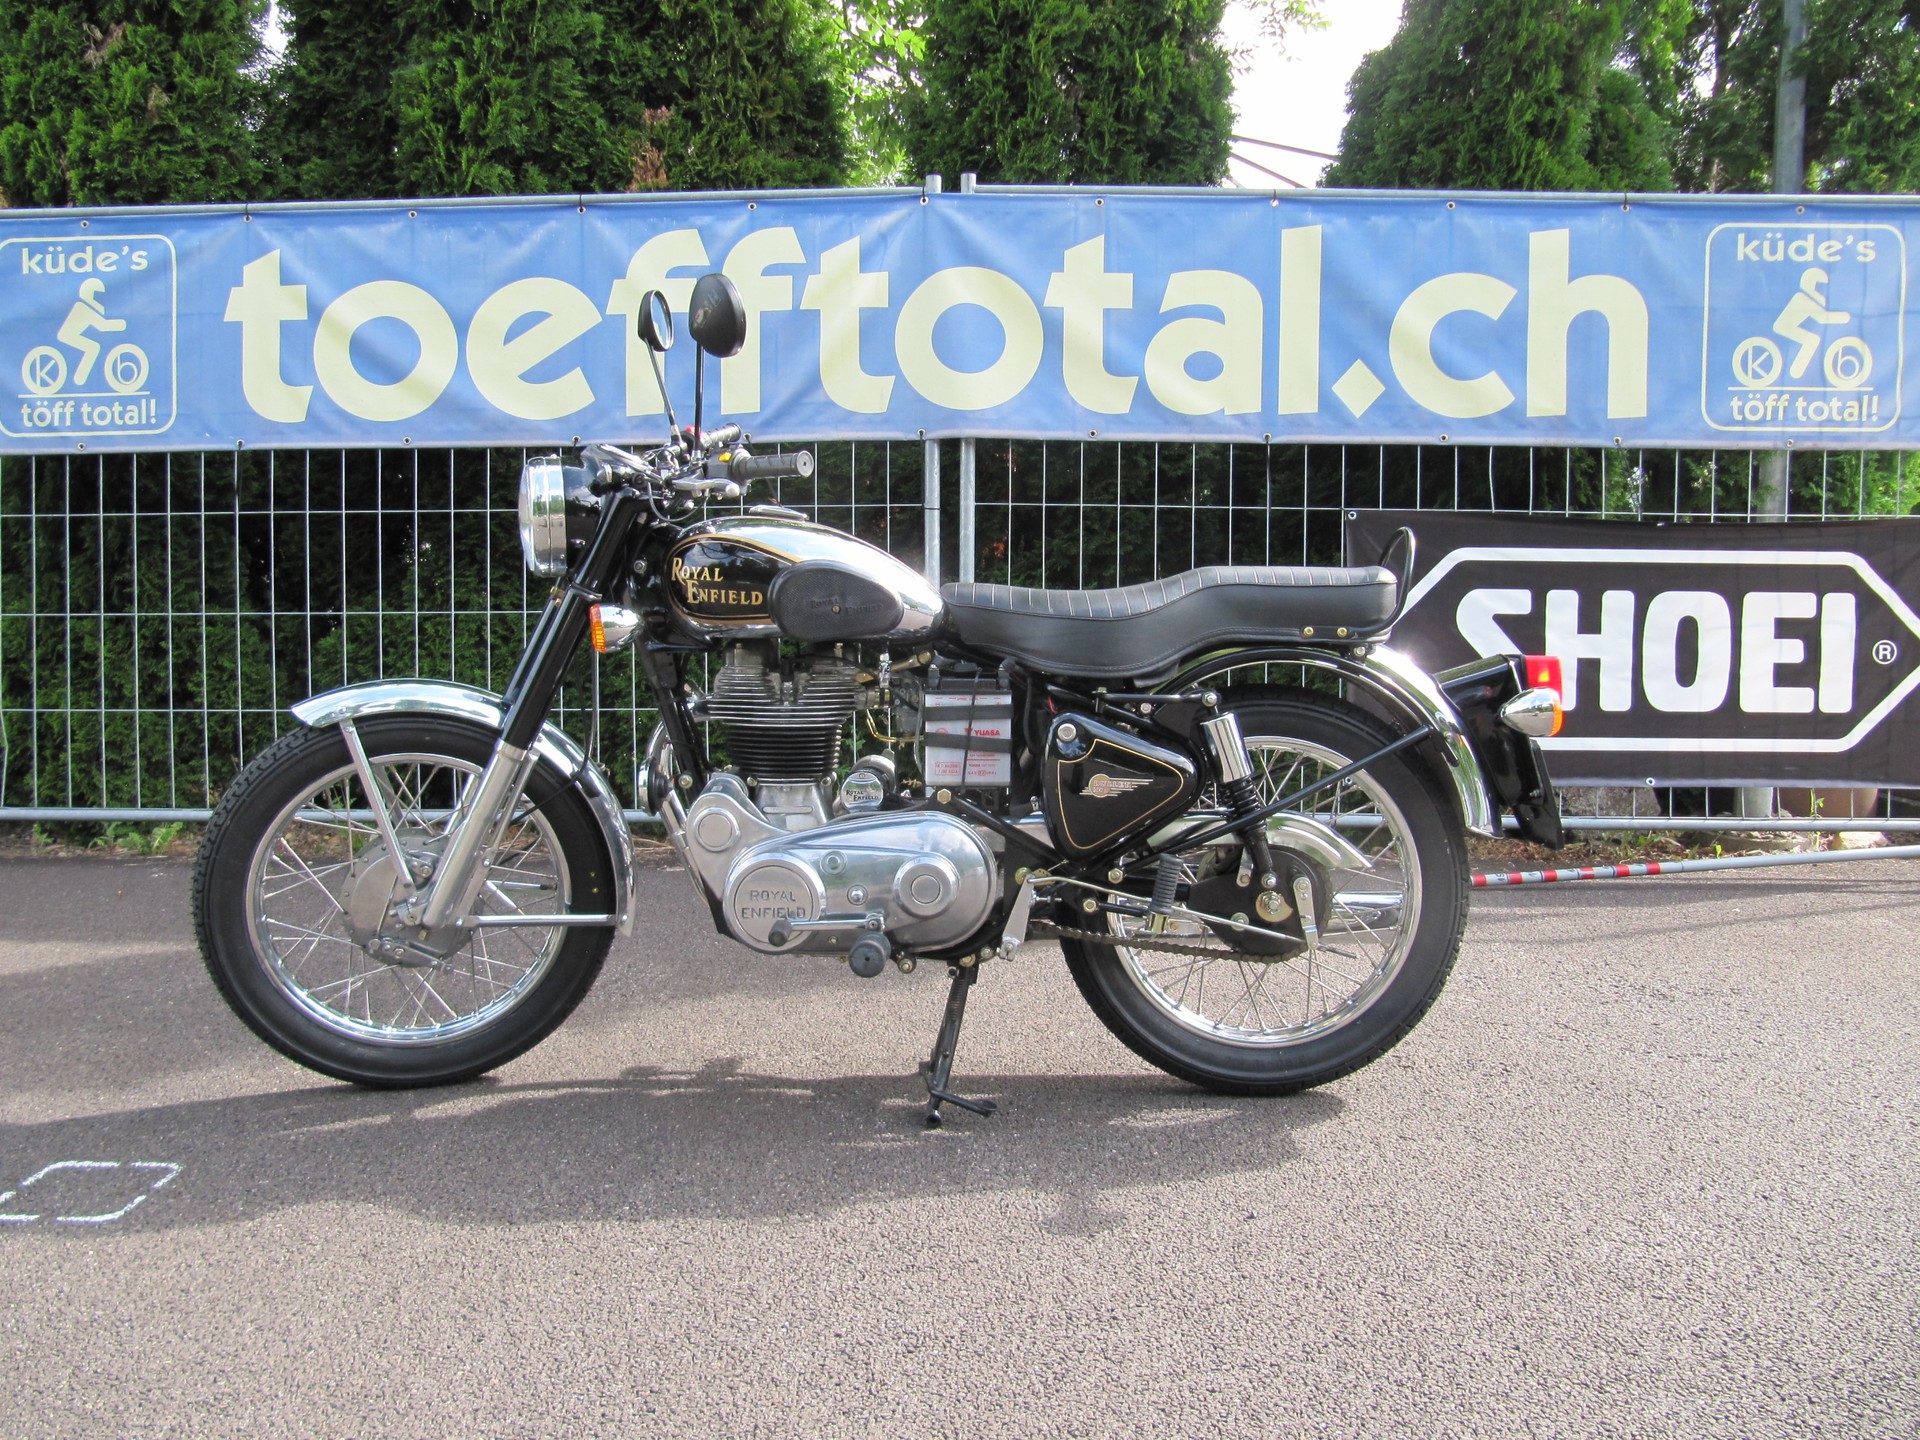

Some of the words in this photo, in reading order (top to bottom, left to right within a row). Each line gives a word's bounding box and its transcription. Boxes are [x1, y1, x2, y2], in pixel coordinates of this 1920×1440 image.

[22, 245, 149, 274] küde's
[1737, 232, 1877, 262] küde's
[223, 225, 1650, 423] toefftotal.ch
[21, 400, 75, 427] töff
[81, 399, 157, 426] total!
[1730, 393, 1790, 421] töff
[1796, 395, 1879, 422] total!
[671, 557, 724, 586] ROYAL
[686, 579, 764, 605] ENFIELD
[1456, 588, 1857, 714] SHOEI
[750, 890, 796, 902] ROYAL
[741, 907, 806, 919] ENFIELD
